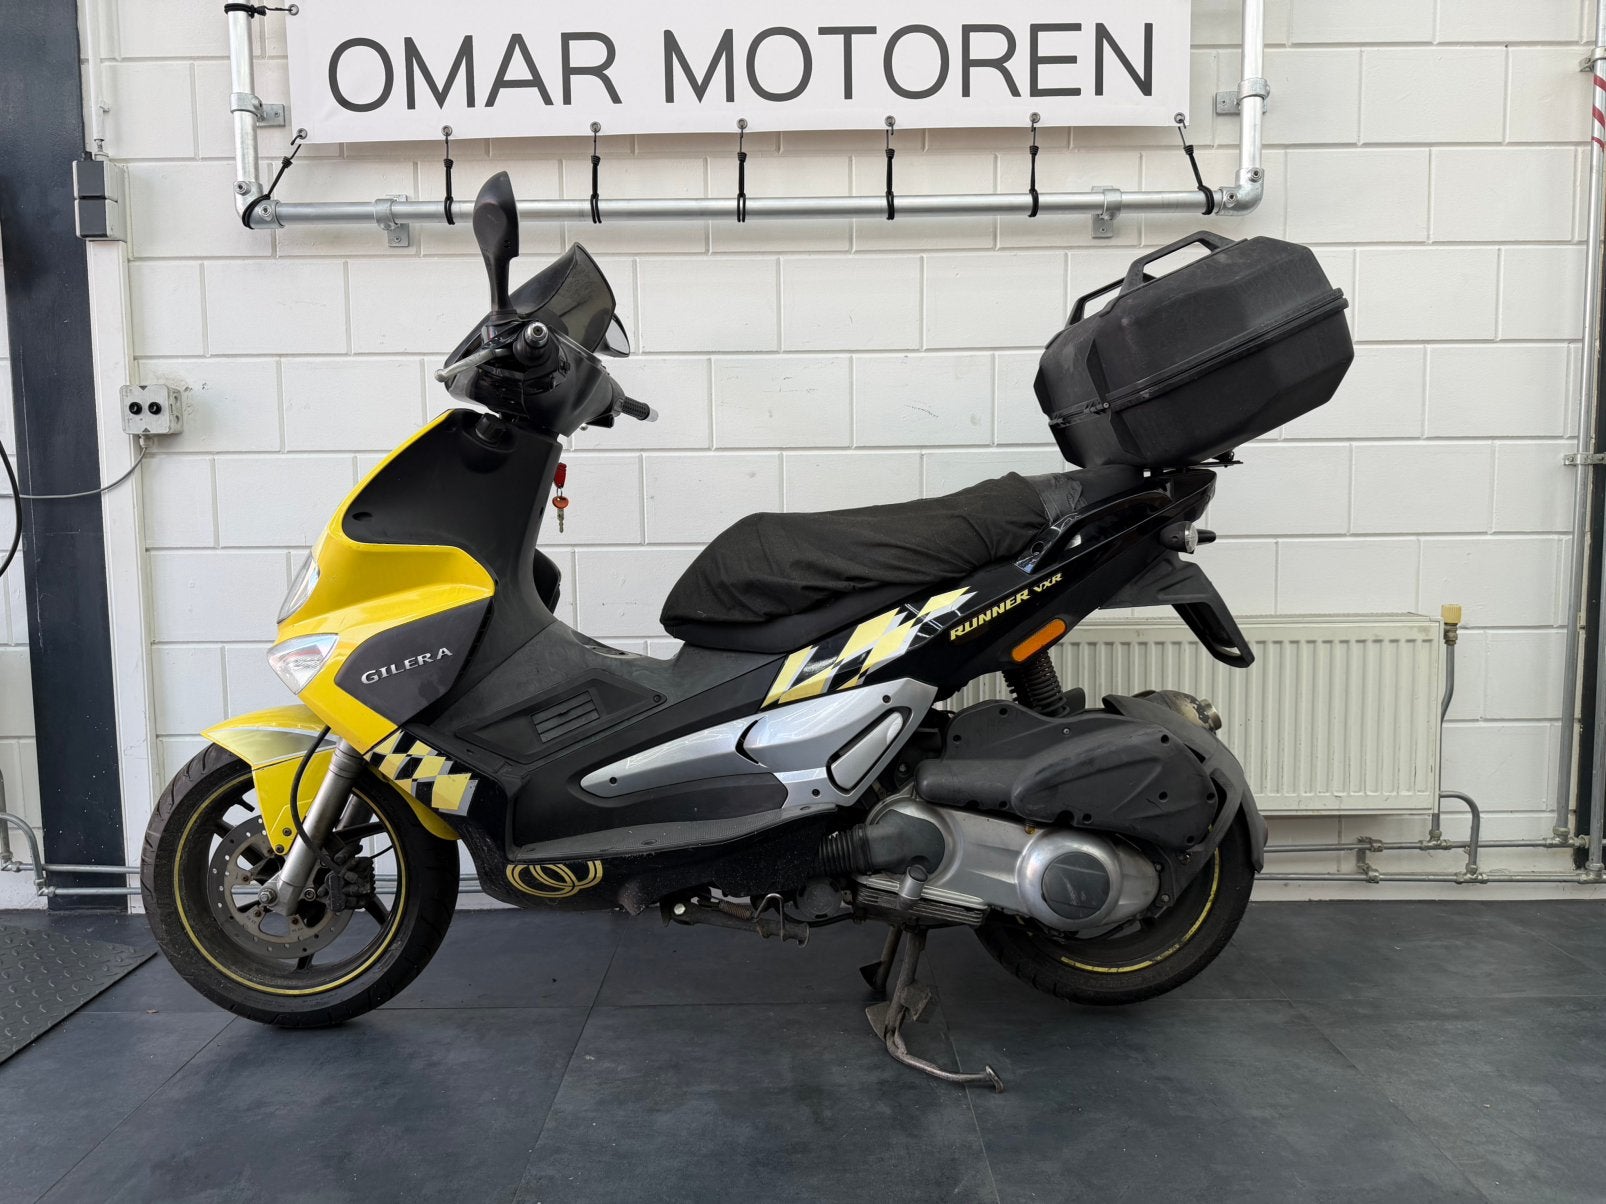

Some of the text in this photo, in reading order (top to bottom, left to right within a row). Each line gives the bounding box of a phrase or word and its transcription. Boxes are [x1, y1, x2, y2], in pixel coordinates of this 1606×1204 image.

[328, 22, 1154, 113] OMAR MOTOREN
[950, 572, 1063, 640] RUNNER VXR
[360, 647, 453, 684] GILERA
